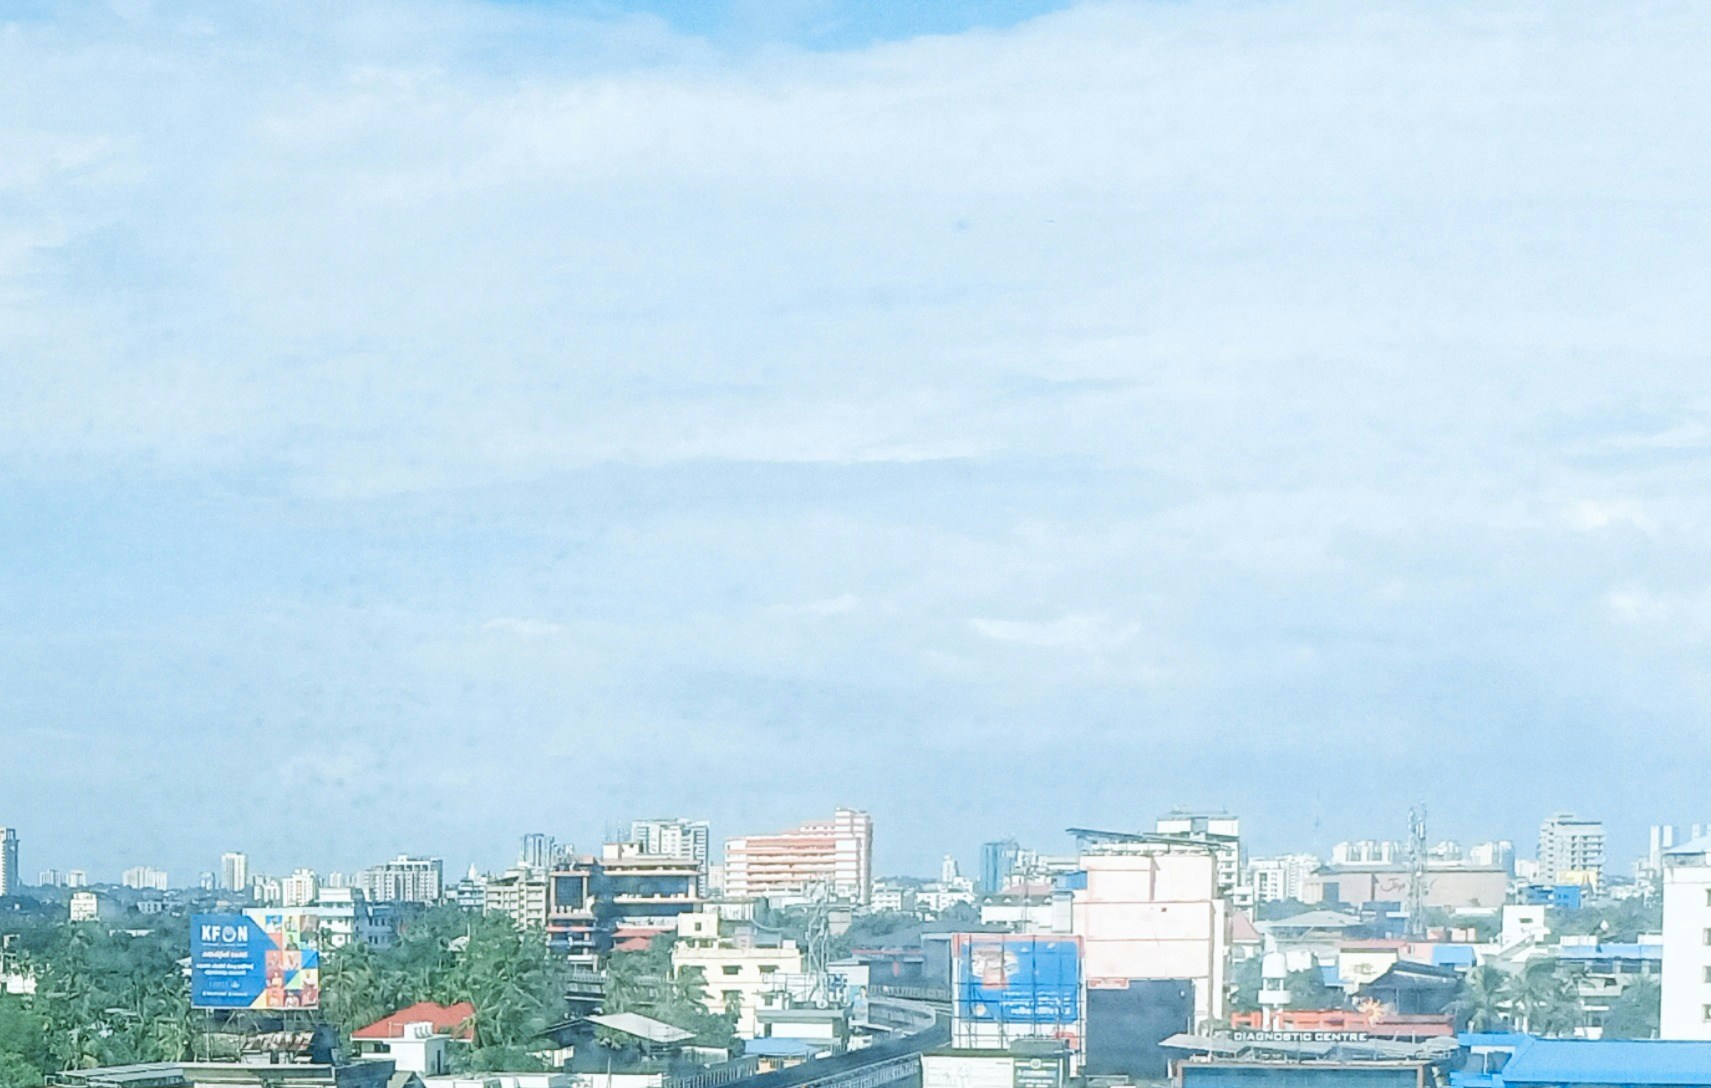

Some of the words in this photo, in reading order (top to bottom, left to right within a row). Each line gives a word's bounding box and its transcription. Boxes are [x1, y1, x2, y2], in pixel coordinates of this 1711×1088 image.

[201, 925, 248, 942] KFON
[1233, 1031, 1312, 1042] DIAGNOSTIC
[1314, 1031, 1368, 1042] CENTRE
